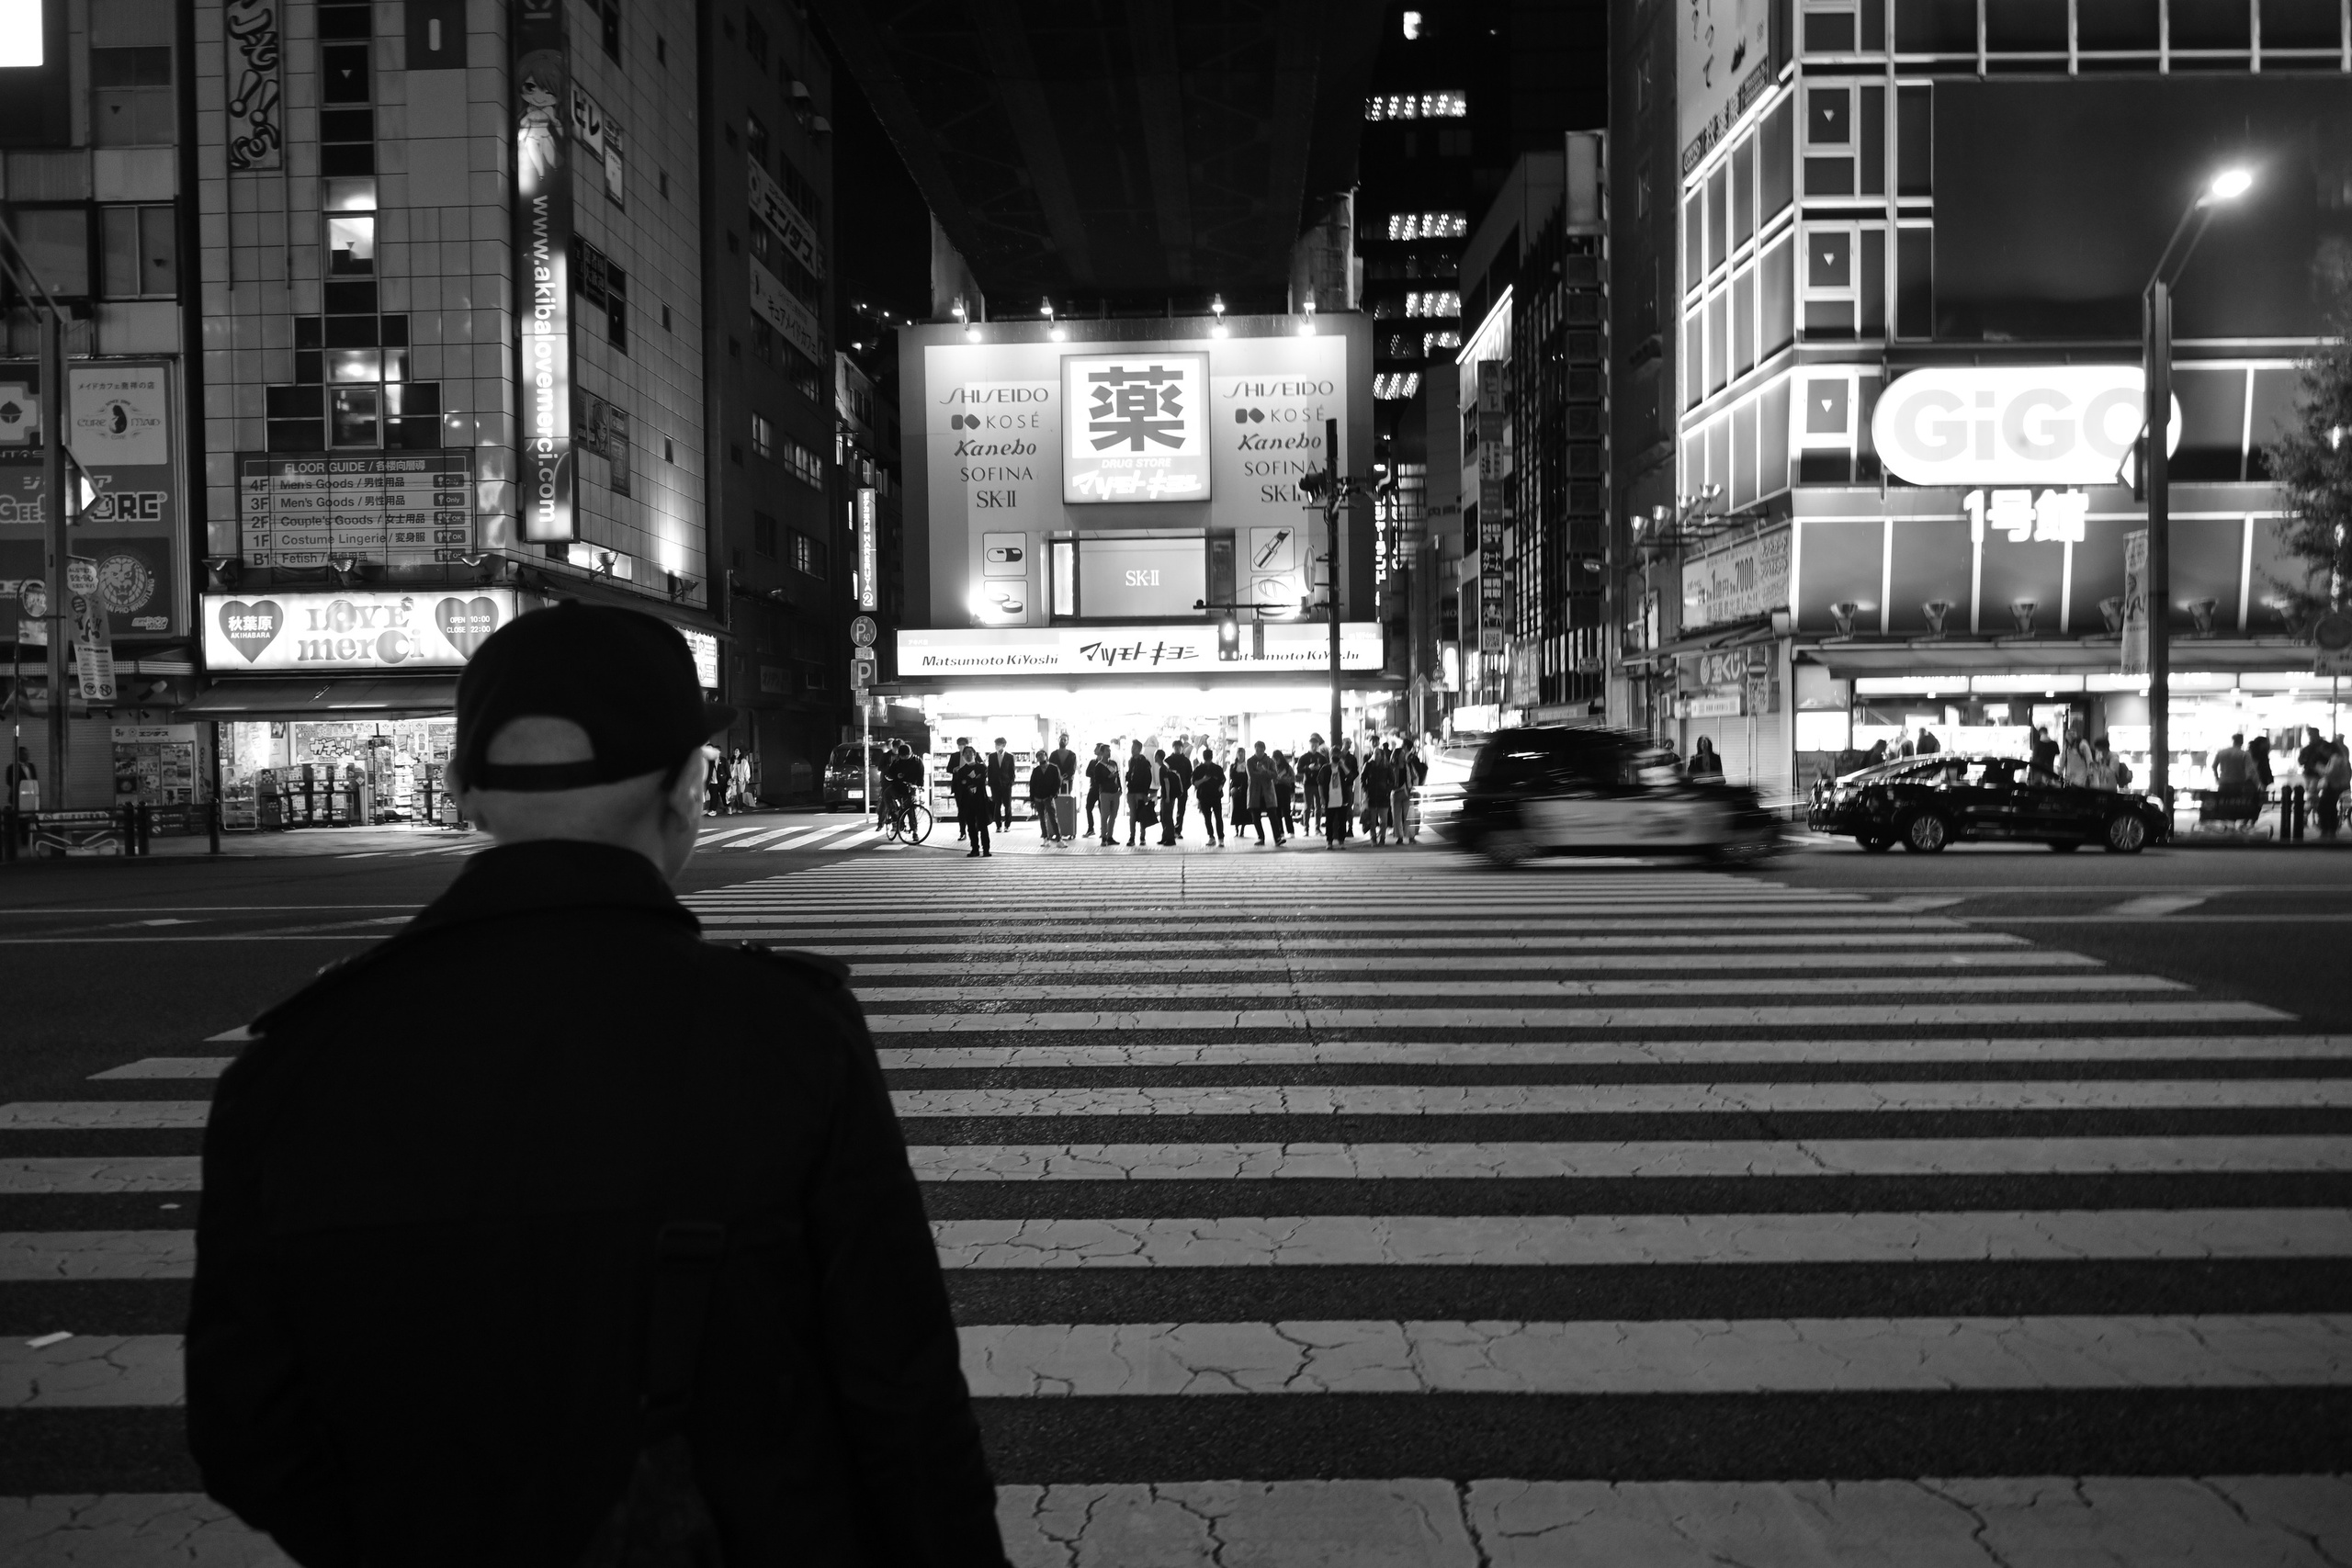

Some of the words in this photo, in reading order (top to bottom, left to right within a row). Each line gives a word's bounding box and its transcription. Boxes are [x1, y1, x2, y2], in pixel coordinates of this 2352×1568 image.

[764, 192, 815, 271] エンタス
[533, 195, 558, 523] www.akibalovemerci.com
[939, 387, 1049, 405] SHISEIDO
[1223, 380, 1334, 399] SHISEIDO
[1088, 366, 1186, 452] 薬
[1271, 404, 1325, 423] KOSÉ
[986, 411, 1039, 429] KOSÉ
[954, 438, 1037, 457] Kanebo
[1237, 432, 1322, 451] Kanebo
[285, 463, 324, 473] FLOOR
[329, 461, 366, 472] GUIDE
[1102, 458, 1134, 469] DRUG
[1136, 457, 1172, 468] STORE
[1244, 460, 1318, 477] SOFINA
[960, 466, 1034, 482] SOFINA
[250, 479, 268, 491] 4F
[280, 479, 313, 490] Men's
[316, 478, 354, 489] Goods
[364, 477, 405, 488] 男性用品
[1072, 469, 1202, 500] マツモトキヨシ
[251, 498, 269, 510] 3F
[280, 497, 313, 508] Men's
[316, 496, 355, 507] Goods
[365, 495, 405, 506] 男性用品
[976, 490, 1017, 508] SK-II
[251, 516, 269, 529] 2F
[280, 515, 331, 527] Couple's
[334, 514, 373, 525] Goods
[1963, 490, 2090, 543] 1号館
[253, 535, 269, 547] 1F
[281, 535, 334, 546] Costume
[338, 533, 386, 546] Lingerie
[395, 532, 425, 543] 変身服
[253, 553, 270, 566] B1
[282, 552, 319, 564] Fetish
[1125, 570, 1160, 587] SK-II
[863, 592, 874, 606] 2
[228, 615, 273, 631] 秋葉原
[305, 599, 412, 634] LOVE
[230, 631, 271, 639] AKIHABARA
[447, 626, 466, 634] CLOSE
[469, 625, 492, 633] 22:00
[856, 624, 866, 642] P
[863, 633, 871, 642] 60
[922, 655, 1004, 666] Matsumoto
[1007, 654, 1058, 665] KiYoshi
[1080, 641, 1200, 667] マツモトキヨシ
[858, 662, 872, 687] P
[1711, 651, 1741, 683] 宝くじ
